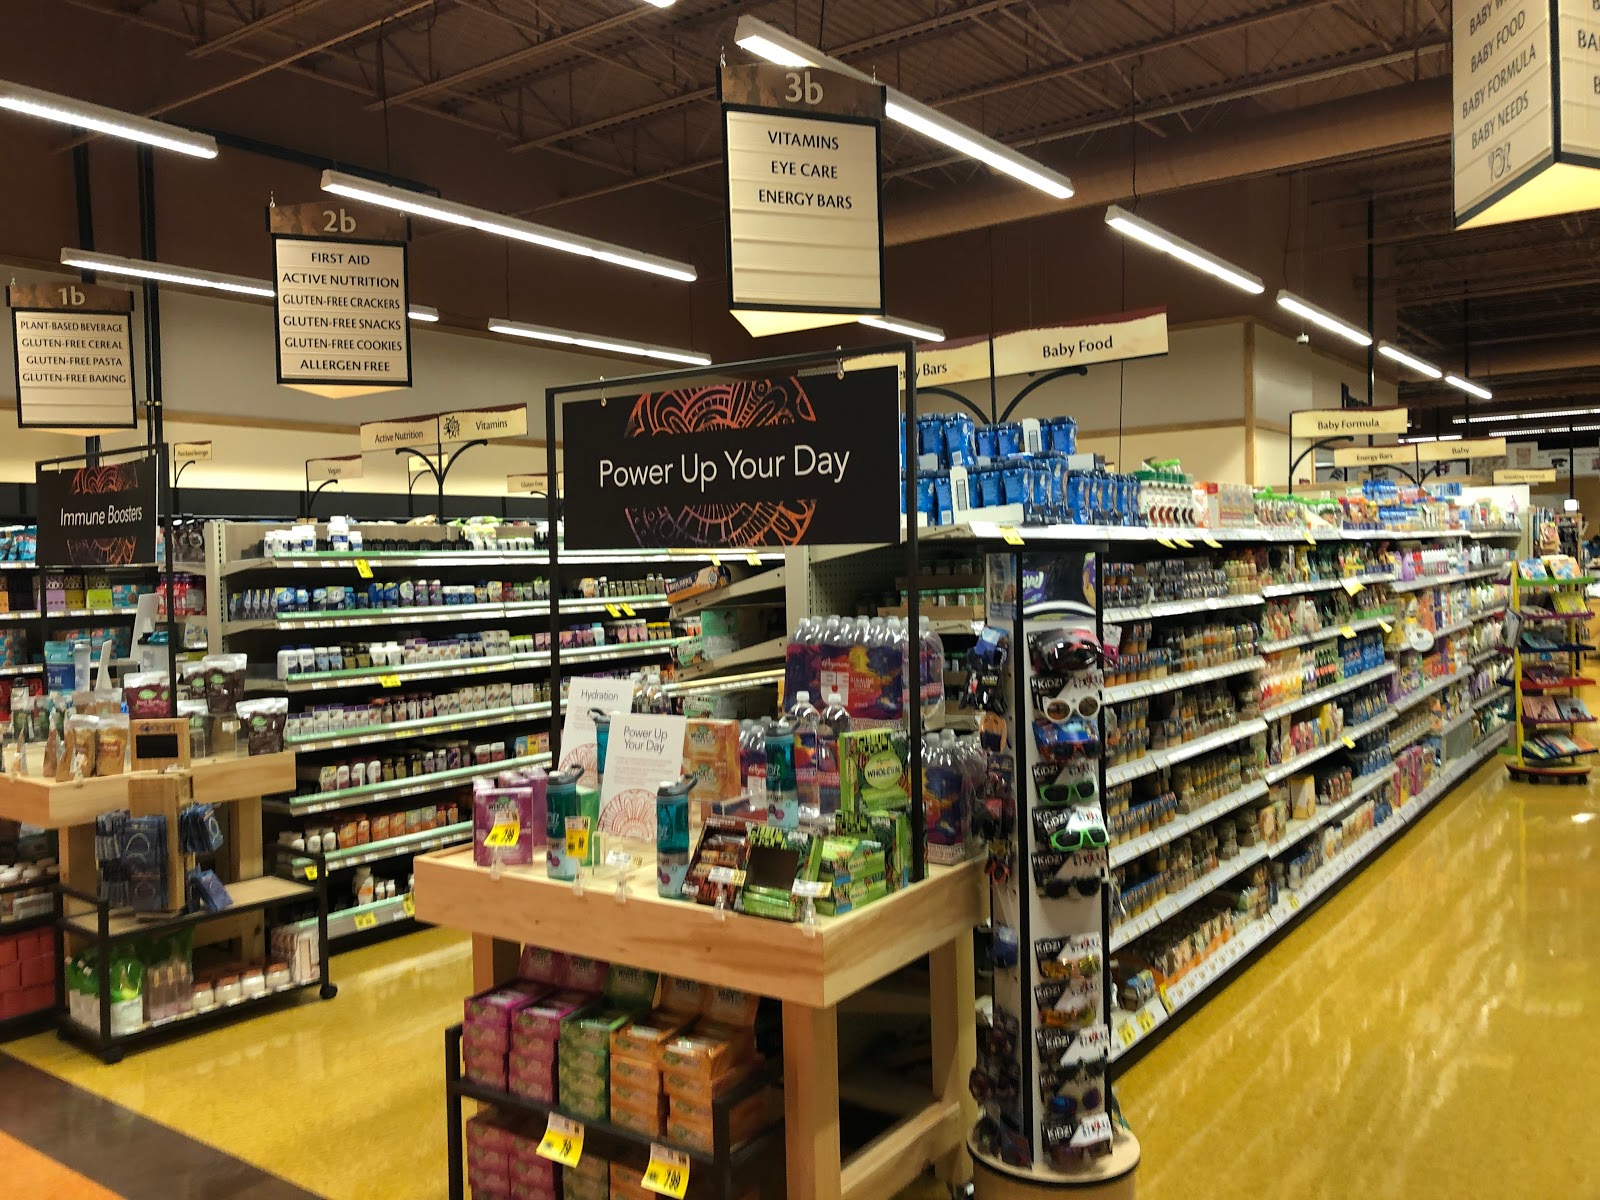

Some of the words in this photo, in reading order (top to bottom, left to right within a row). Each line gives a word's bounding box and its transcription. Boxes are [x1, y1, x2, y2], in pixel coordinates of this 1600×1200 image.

[1470, 0, 1492, 36] BABY
[1471, 39, 1494, 73] BABY
[1496, 10, 1525, 50] FOOD
[785, 72, 824, 105] 3b
[1462, 85, 1486, 120] BABY
[1488, 43, 1537, 95] FORMULA
[1471, 116, 1495, 150] BABY
[1498, 90, 1529, 126] NEEDS
[768, 130, 839, 150] VITAMINS
[771, 160, 797, 176] EYE
[801, 163, 838, 179] CARE
[759, 189, 814, 206] ENERGY
[817, 194, 853, 210] BARS
[322, 210, 357, 233] 2b
[311, 252, 343, 264] FIRST
[348, 254, 371, 266] AID
[282, 272, 328, 285] ACTIVE
[329, 274, 400, 288] NUTRITION
[58, 288, 86, 306] 1b
[282, 293, 349, 308] GLUTEN-FREE
[350, 296, 401, 310] CRACKERS
[20, 321, 79, 332] PLANT-BASED
[80, 321, 123, 333] BEVERAGE
[282, 315, 357, 329] GLUTEN-FREE
[358, 318, 401, 331] SNACKS
[21, 338, 87, 349] GLUTEN-FREE
[87, 339, 123, 350] CEREAL
[284, 336, 356, 350] GLUTEN-FREE
[356, 339, 403, 352] COOKIES
[1042, 344, 1075, 359] Baby
[1079, 335, 1113, 352] Food
[26, 355, 91, 366] GLUTEN-FREE
[92, 356, 123, 367] PASTA
[299, 358, 363, 372] ALLERGEN
[364, 360, 391, 372] FREE
[923, 362, 948, 377] Bars
[22, 373, 88, 383] GLUTEN-FREE
[89, 374, 127, 384] BAKING
[476, 419, 508, 431] Vitamins
[1317, 420, 1340, 431] Baby
[1341, 418, 1380, 429] Formula
[374, 432, 394, 443] Active
[395, 430, 424, 442] Nutrition
[1356, 454, 1378, 462] Energy
[600, 459, 673, 487] Power
[681, 453, 717, 492] Up
[724, 449, 786, 480] Your
[794, 444, 850, 484] Day
[60, 507, 105, 527] Immune
[107, 504, 143, 524] Boosters
[581, 689, 619, 702] Hydration
[623, 726, 652, 739] Power
[654, 729, 668, 743] Up
[624, 738, 645, 750] Your
[646, 742, 665, 755] Day
